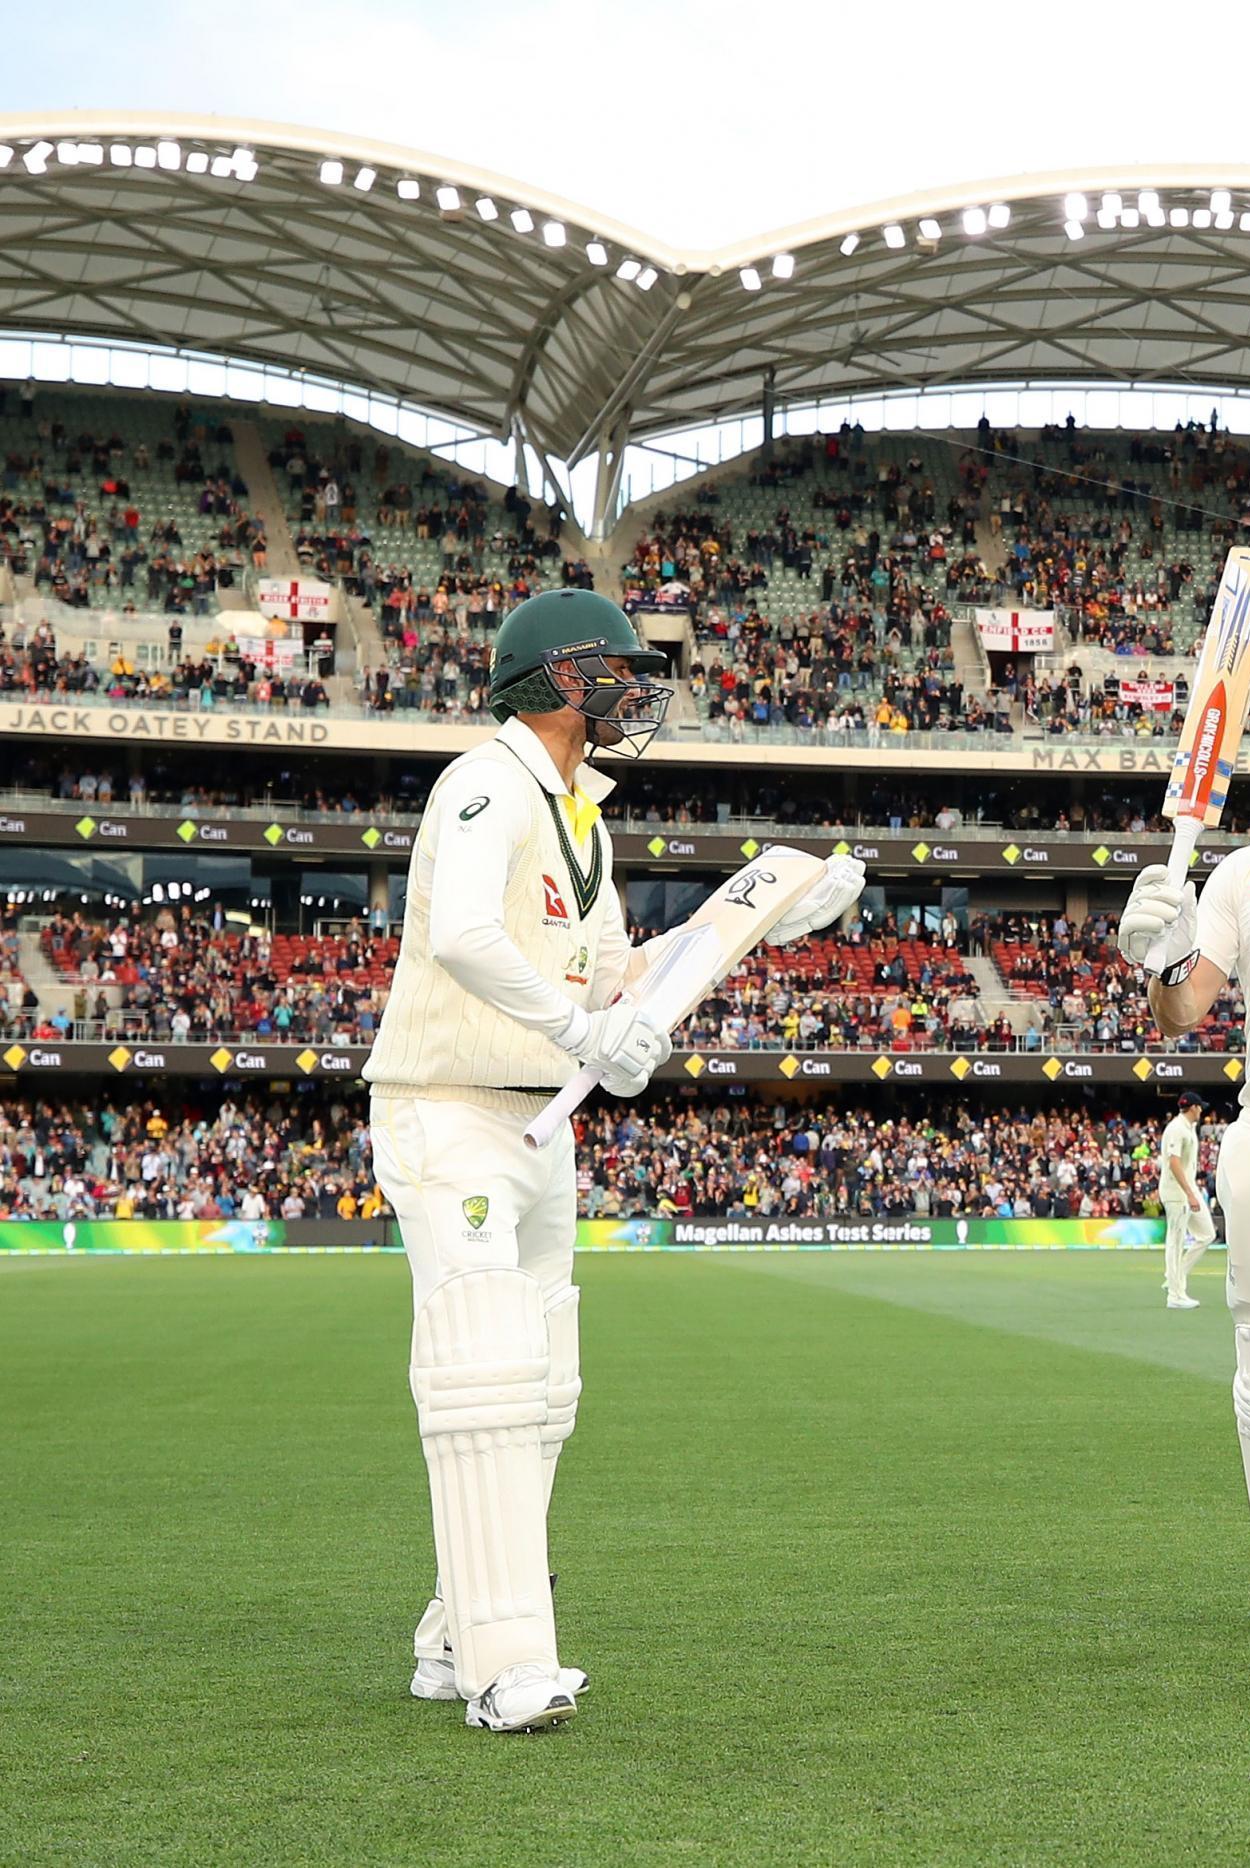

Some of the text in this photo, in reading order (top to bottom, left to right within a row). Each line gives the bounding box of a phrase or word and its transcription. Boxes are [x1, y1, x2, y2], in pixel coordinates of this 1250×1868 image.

[9, 709, 329, 743] JACK OATEY STAND
[1032, 747, 1102, 770] MAX
[0, 816, 25, 833] Can
[100, 821, 127, 837] Can
[201, 824, 228, 840] Can
[287, 828, 314, 843] Can
[384, 831, 411, 847] Can
[668, 840, 695, 855] Can
[852, 844, 879, 859] Can
[932, 846, 959, 860] Can
[1023, 847, 1049, 862] Can
[1111, 849, 1138, 863] Can
[541, 918, 571, 930] QANTAS
[30, 1048, 62, 1066] Can
[133, 1050, 165, 1068] Can
[236, 1051, 266, 1069] Can
[321, 1053, 351, 1070] Can
[708, 1058, 737, 1074] Can
[802, 1058, 831, 1075] Can
[894, 1059, 923, 1076] Can
[972, 1060, 1001, 1076] Can
[1064, 1061, 1093, 1077] Can
[1155, 1061, 1184, 1077] Can
[462, 1230, 492, 1238] CRICKET
[675, 1222, 932, 1246] Magellan Ashes Test Series
